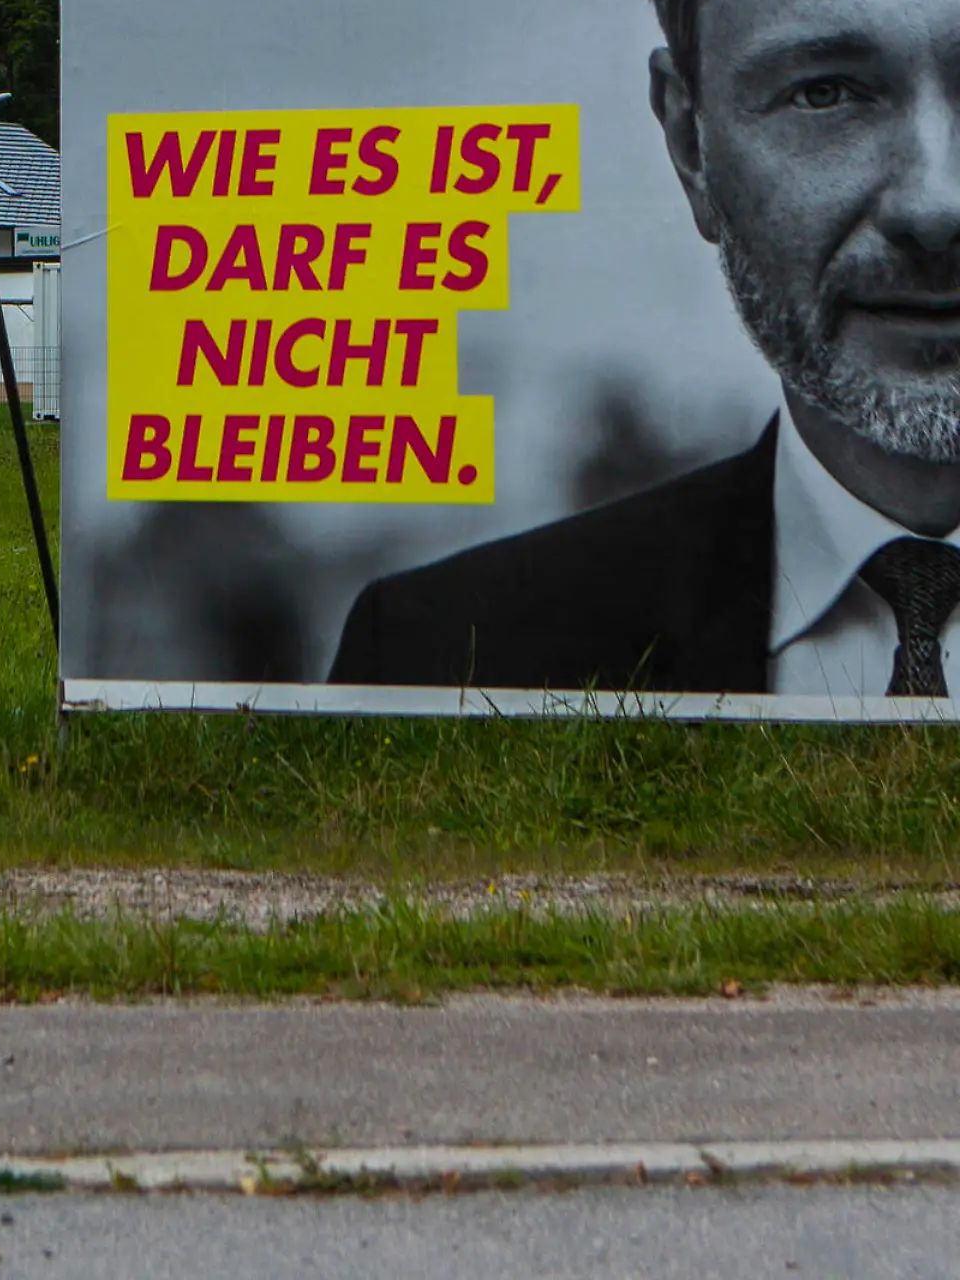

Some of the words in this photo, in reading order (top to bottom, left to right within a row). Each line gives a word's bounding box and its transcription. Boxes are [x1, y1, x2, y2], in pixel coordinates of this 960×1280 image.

[125, 128, 281, 199] WIE
[308, 125, 401, 197] ES
[429, 123, 561, 205] IST,
[149, 223, 372, 292] DARF
[398, 220, 490, 292] ES
[176, 317, 439, 388] NICHT
[121, 414, 478, 486] BLEIBEN.
